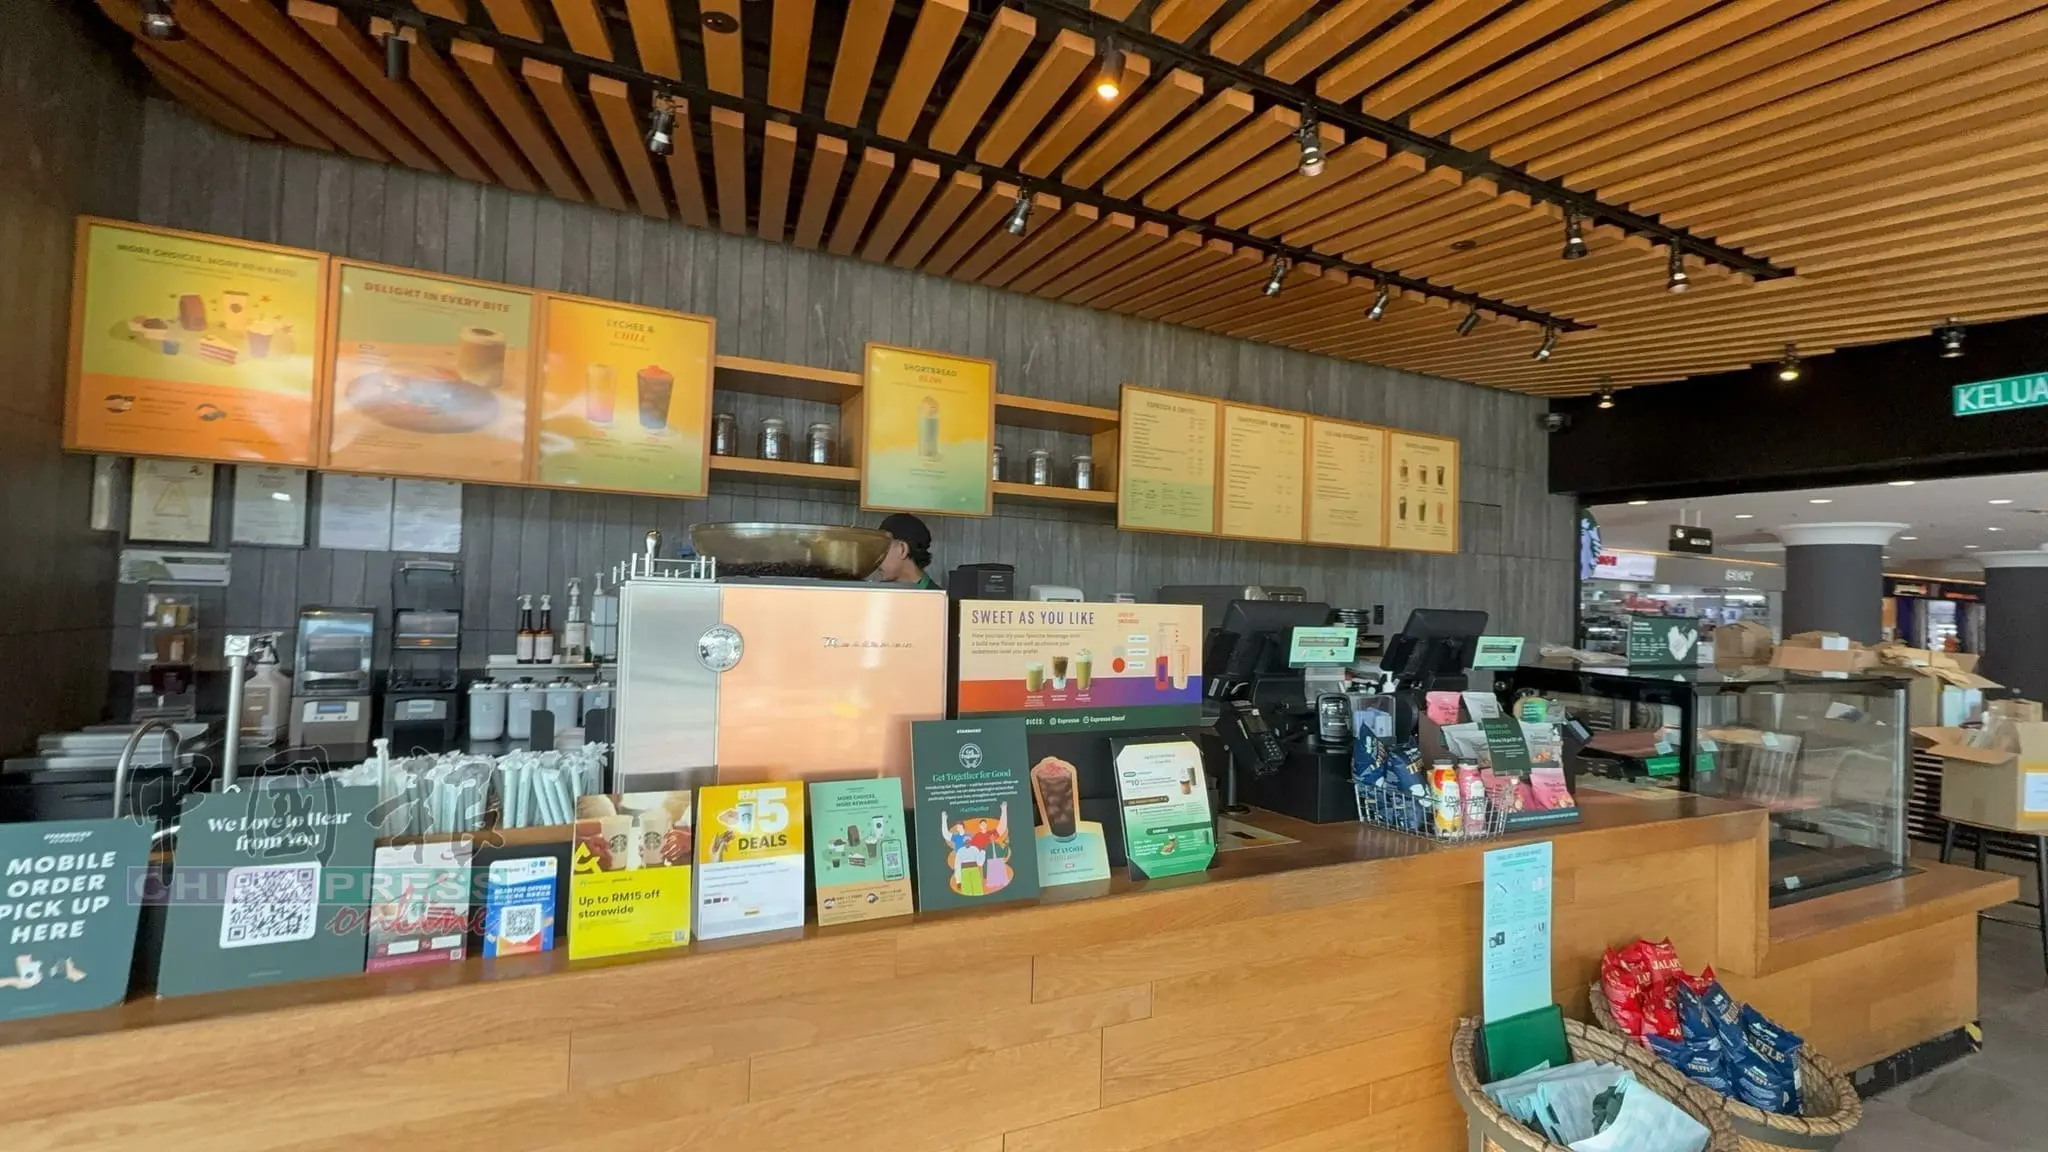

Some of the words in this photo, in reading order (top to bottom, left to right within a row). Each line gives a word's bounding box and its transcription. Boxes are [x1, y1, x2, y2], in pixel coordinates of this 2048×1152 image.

[363, 281, 421, 297] DELIGHT
[424, 291, 439, 301] IN
[440, 294, 481, 308] EVERY
[483, 302, 511, 313] BITE
[606, 318, 645, 331] LYCHEE
[903, 363, 958, 377] SHORTBREAD
[1957, 376, 2048, 411] KELUA
[971, 609, 1013, 625] SWEET
[1018, 610, 1035, 625] AS
[1040, 611, 1065, 625] YOU
[1069, 612, 1096, 625] LIKE
[1057, 717, 1080, 725] Espresso
[1090, 715, 1111, 724] Espresso
[1111, 714, 1126, 722] Decaf
[932, 773, 946, 782] Get
[946, 771, 980, 782] Together
[980, 770, 990, 780] for
[991, 768, 1012, 778] Good
[207, 816, 237, 833] We
[239, 815, 284, 832] Love
[284, 812, 305, 828] to
[307, 811, 353, 827] Hear
[234, 833, 283, 851] from
[285, 832, 321, 848] You
[738, 834, 788, 851] DEALS
[5, 850, 118, 876] MOBILE
[7, 873, 107, 898] ORDER
[0, 899, 65, 920] PICK
[71, 895, 111, 915] UP
[578, 895, 594, 908] Up
[597, 894, 609, 904] to
[611, 890, 642, 903] RM15
[643, 889, 661, 900] off
[578, 905, 635, 919] storewide
[9, 919, 87, 945] HERE
